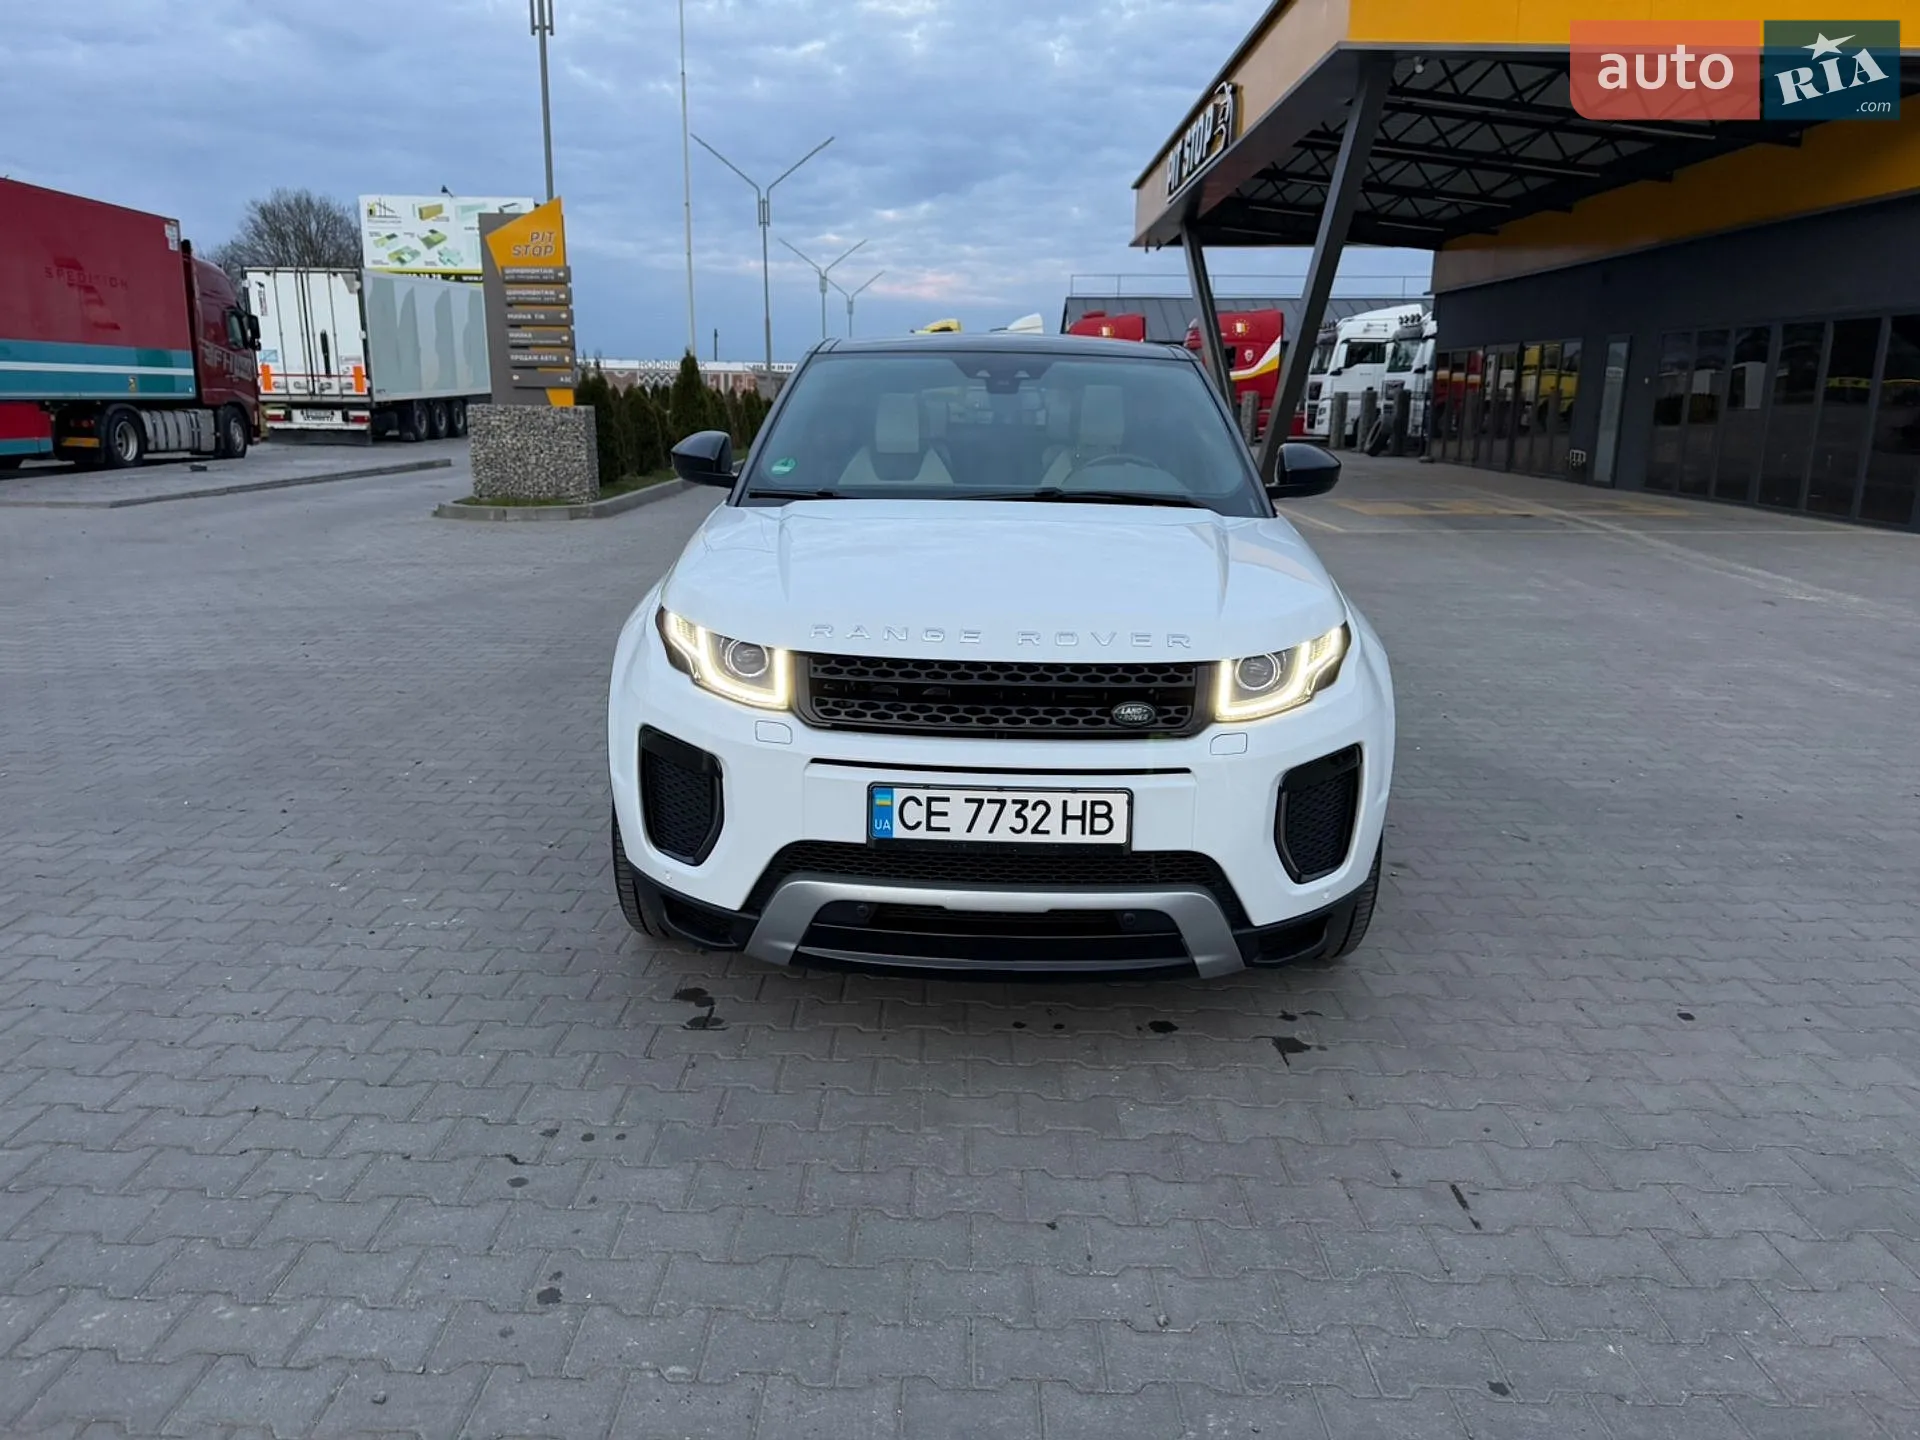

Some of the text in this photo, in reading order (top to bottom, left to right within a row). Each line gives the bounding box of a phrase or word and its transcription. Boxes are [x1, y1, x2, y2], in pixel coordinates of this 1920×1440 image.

[1167, 102, 1214, 196] PIT STOP
[530, 231, 556, 243] PIT
[512, 245, 556, 257] STOP
[44, 265, 129, 291] SPEDITION
[809, 623, 1192, 649] RANGE ROVER
[874, 819, 892, 831] UA
[898, 795, 1114, 836] CE 7732 HB
